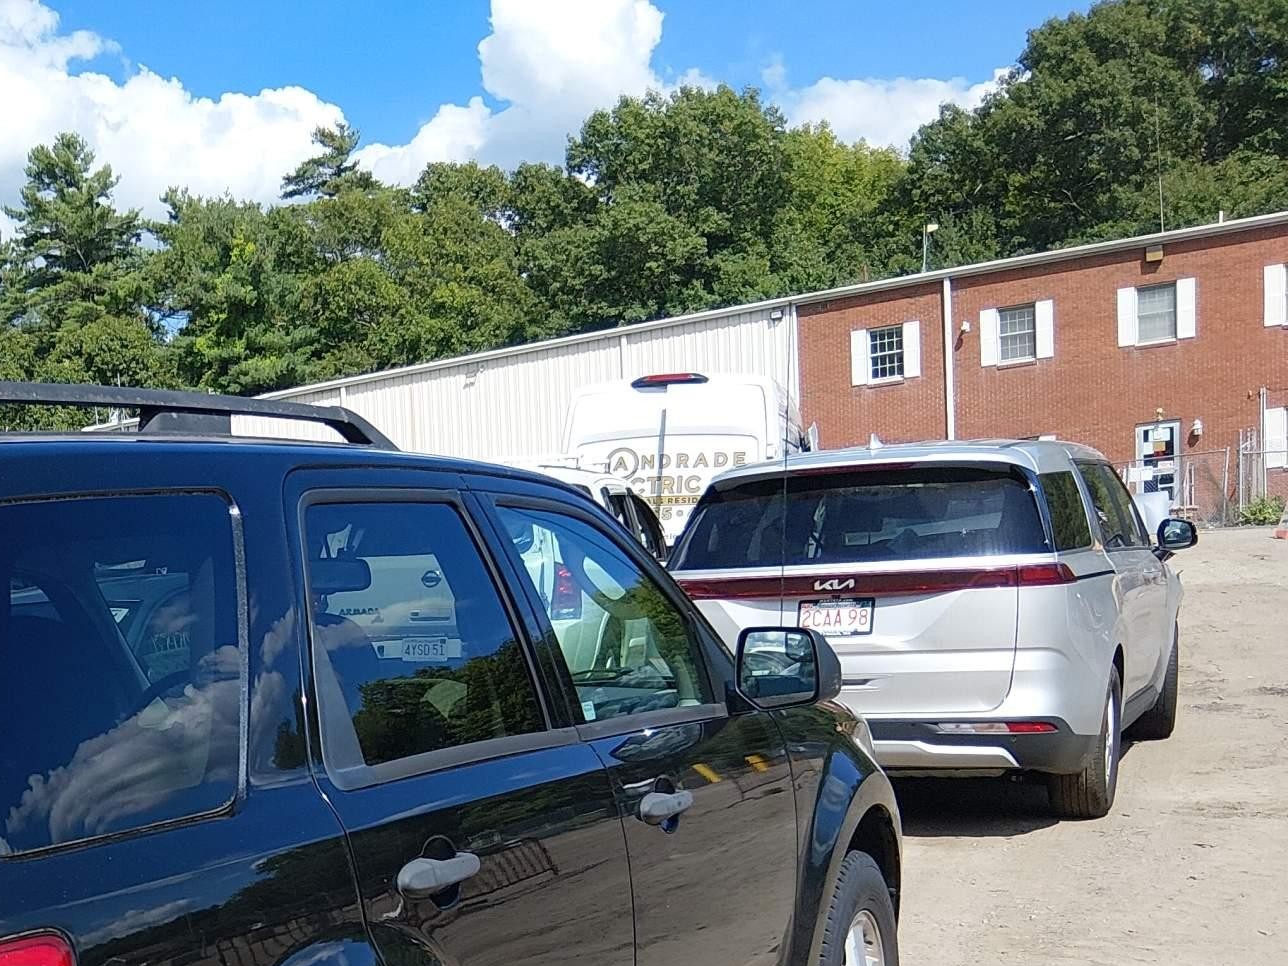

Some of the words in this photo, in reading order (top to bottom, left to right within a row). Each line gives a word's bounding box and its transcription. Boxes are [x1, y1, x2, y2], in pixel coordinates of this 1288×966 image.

[612, 451, 747, 472] ANDRADE
[814, 578, 855, 591] KIA
[802, 608, 842, 628] 2CAA
[848, 608, 869, 626] 98
